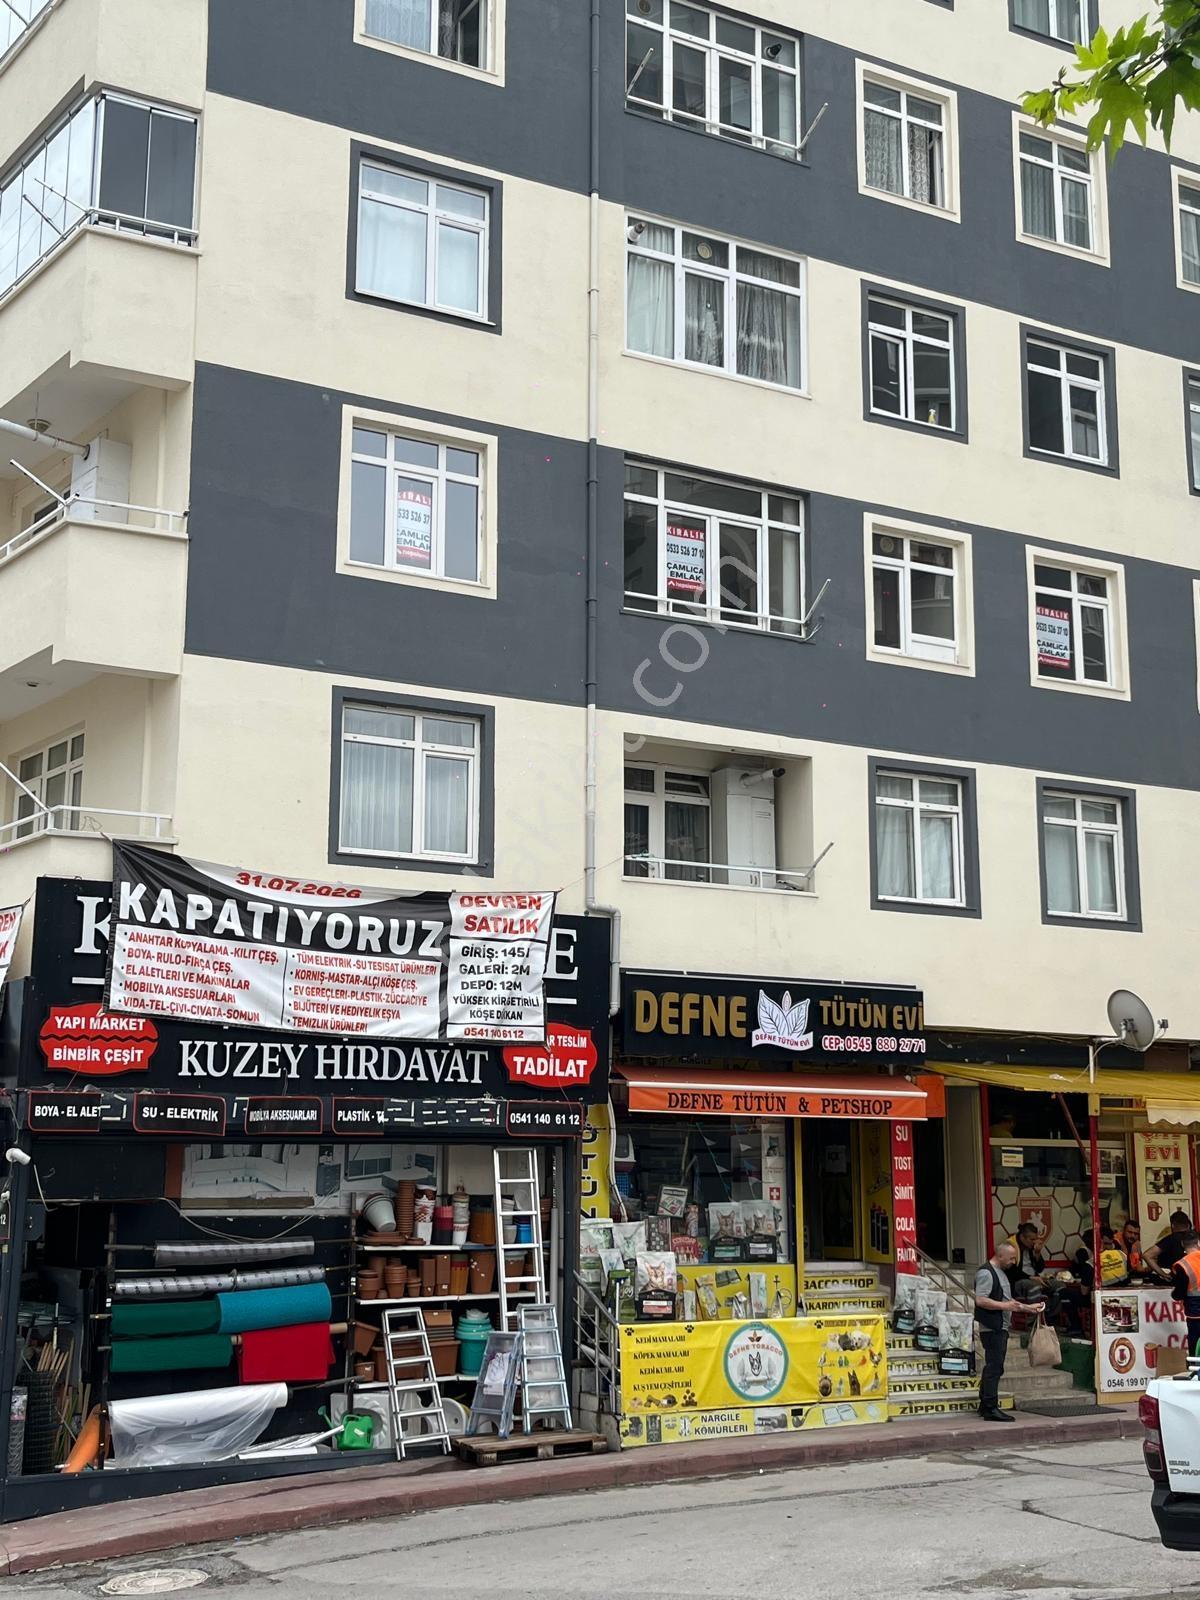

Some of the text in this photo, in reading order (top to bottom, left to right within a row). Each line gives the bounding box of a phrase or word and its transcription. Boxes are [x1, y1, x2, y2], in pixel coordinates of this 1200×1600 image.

[667, 526, 704, 540] KIRALIK
[680, 546, 690, 556] 526
[692, 548, 698, 558] 37
[667, 562, 704, 575] ÇAMLICA
[670, 571, 702, 582] EMLAK
[1036, 606, 1069, 620] KIRALIK
[1039, 648, 1066, 658] EMLAK
[236, 872, 362, 899] 31.07.2026
[119, 881, 445, 957] KAPATIYORUZ
[464, 914, 540, 934] SATILIK
[128, 932, 172, 948] ANAHTAR
[174, 938, 228, 957] KOPYALAMA
[297, 952, 314, 964] TÜM
[461, 944, 499, 962] GİRİŞ:
[126, 965, 137, 975] EL
[182, 971, 194, 982] VE
[460, 962, 530, 976] GALERİ: 2M
[294, 985, 304, 996] EV
[381, 977, 400, 991] KÖŞE
[460, 980, 522, 990] DEPO: 12M
[166, 986, 236, 1004] AKSESUARLARI
[453, 994, 490, 1005] YÜKSEK
[330, 1005, 340, 1015] VE
[382, 1009, 400, 1022] EŞYA
[470, 1008, 495, 1021] KÖŞE
[634, 990, 924, 1038] DEFNE TÜTÜN EVİ
[54, 1016, 146, 1032] YAPI MARKET
[464, 1028, 488, 1037] 0541
[557, 1034, 587, 1048] TESLİM
[755, 1033, 810, 1048] DEFNE TÜTÜN EVİ
[876, 1038, 897, 1052] 880
[900, 1038, 926, 1053] 2771
[53, 1046, 144, 1065] BİNBİR ÇEŞİT
[178, 1040, 308, 1078] KUZEY
[512, 1054, 588, 1078] TADİLAT
[667, 1092, 892, 1116] DEFNE TÜTÜN & PETSHOP
[34, 1106, 60, 1117] BOYA
[66, 1106, 78, 1117] EL
[142, 1107, 158, 1118] SU
[166, 1106, 219, 1122] ELEKTRİK
[270, 1110, 318, 1121] AKSESUARLARI
[338, 1108, 370, 1122] PLASTİK
[510, 1113, 580, 1125] 0541 140 61 12
[896, 1125, 908, 1142] SU
[1144, 1142, 1180, 1162] EVİ
[894, 1156, 912, 1170] TOST
[894, 1184, 914, 1200] SİMİT
[896, 1217, 915, 1232] COLA
[897, 1248, 917, 1262] FANTA
[636, 1335, 686, 1344] KEDİ MAMALARI
[634, 1350, 690, 1360] KÖPEK MAMALARI
[728, 1344, 784, 1360] DEFNE TOBACCO
[640, 1365, 684, 1376] KEDİ KUMLARI
[633, 1380, 692, 1392] KUŞ YEM ÇEŞİTLERİ
[1108, 1378, 1124, 1388] 0546
[1126, 1378, 1138, 1388] 199
[900, 1402, 945, 1415] ZİPPO
